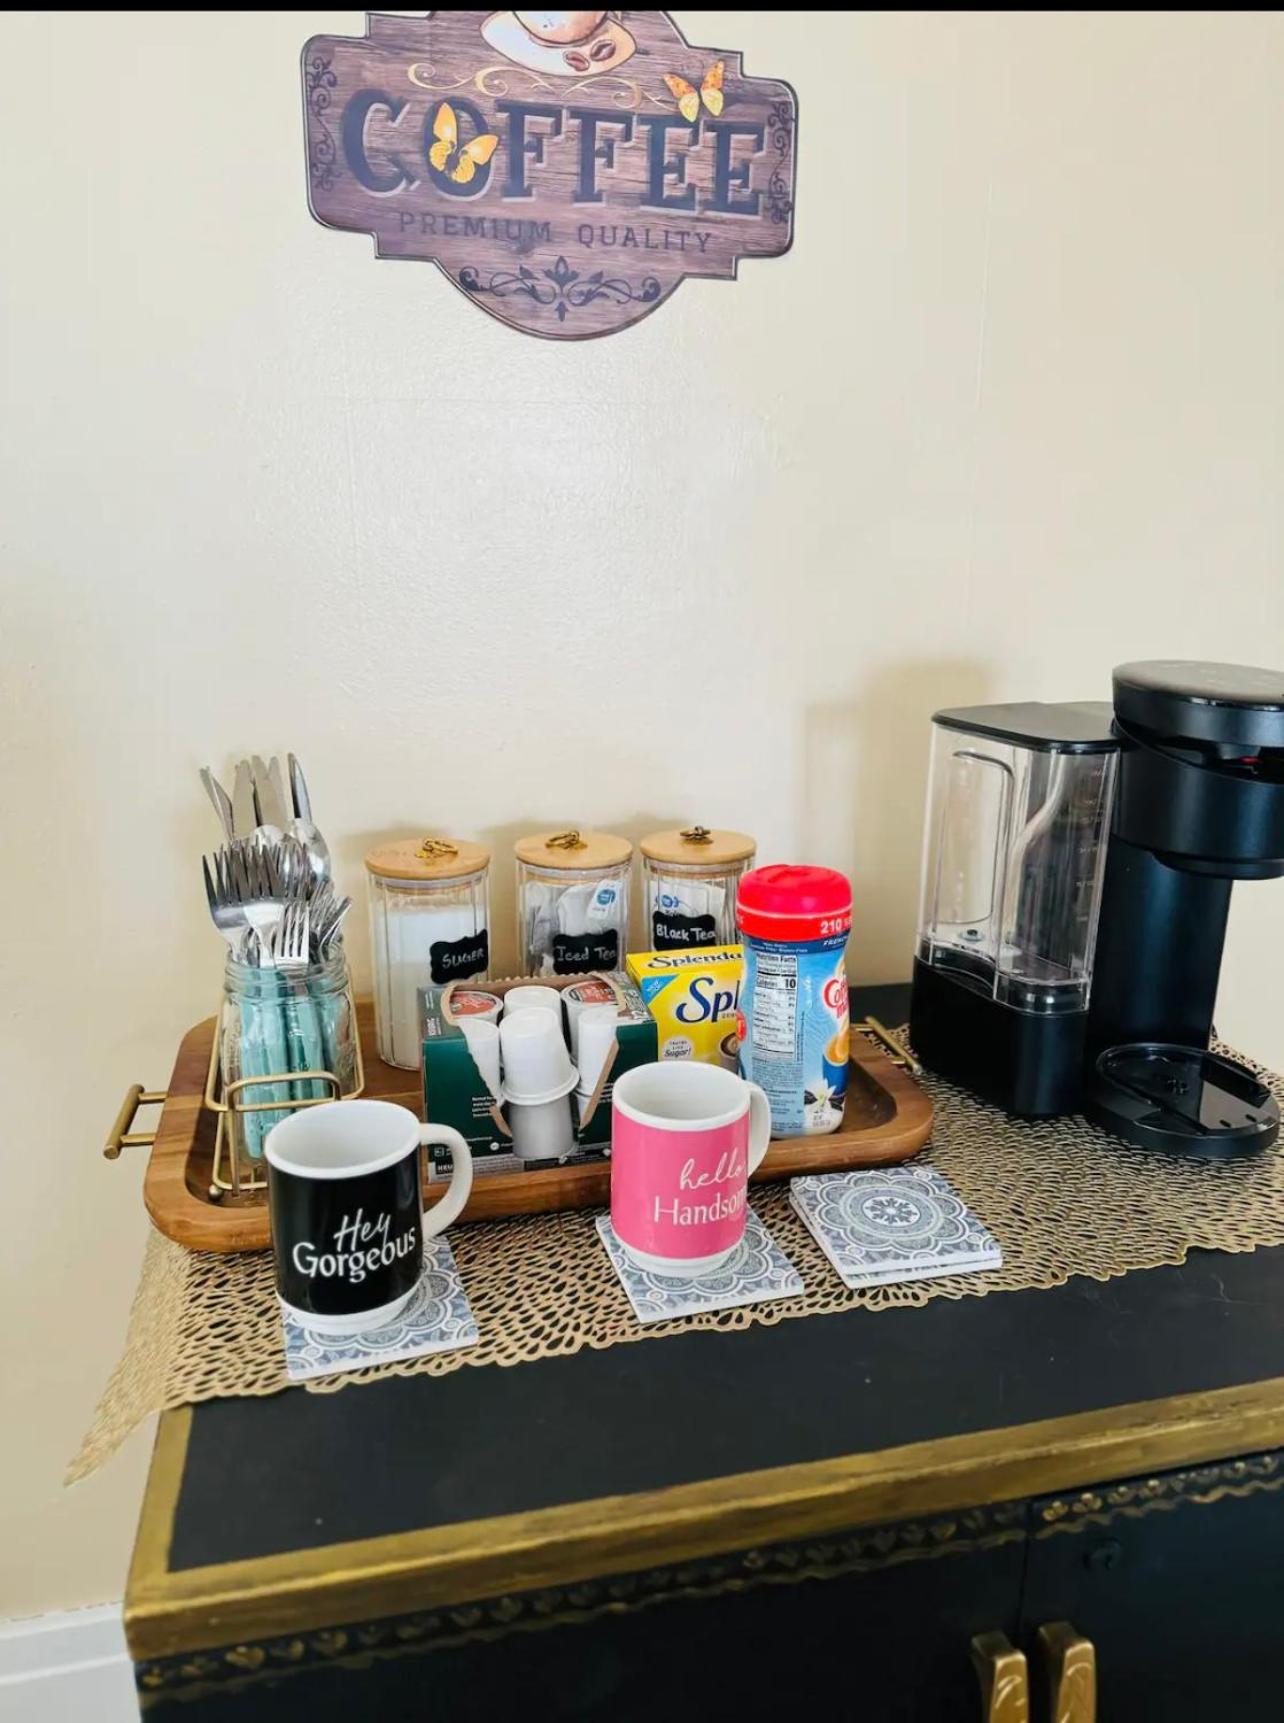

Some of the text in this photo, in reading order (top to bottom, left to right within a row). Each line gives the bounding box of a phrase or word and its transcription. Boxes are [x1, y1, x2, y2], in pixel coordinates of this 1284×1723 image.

[342, 88, 767, 216] COFFEE
[400, 212, 713, 253] PREMIUM QUALITY
[656, 923, 717, 942] Black Tea
[820, 918, 842, 934] 210
[555, 945, 617, 962] Iced Tea
[648, 951, 743, 969] Splenda
[675, 975, 741, 1024] Spl
[784, 978, 797, 989] 10
[679, 1147, 745, 1191] hello
[654, 1185, 748, 1226] Handsom
[333, 1208, 391, 1252] Hey
